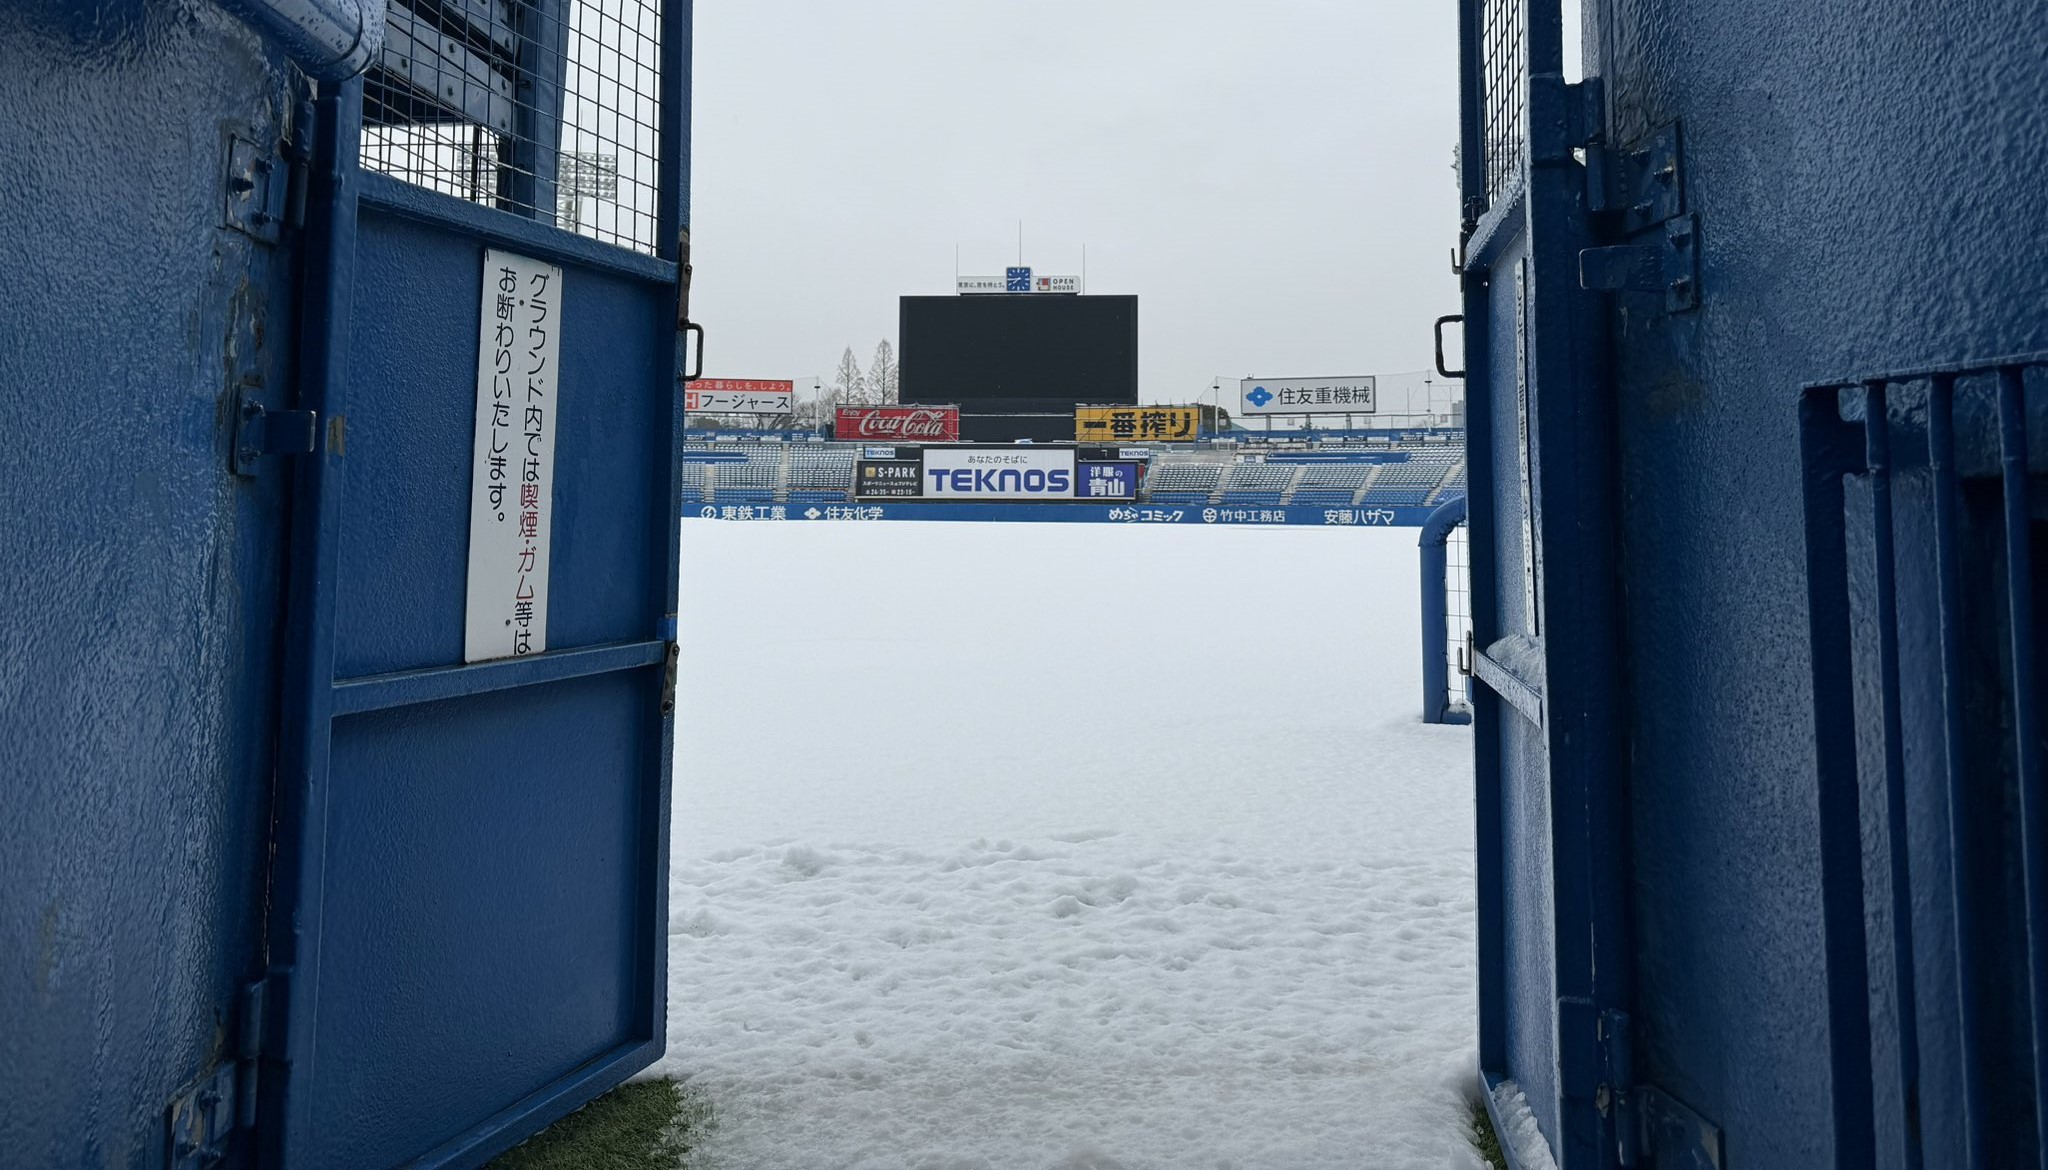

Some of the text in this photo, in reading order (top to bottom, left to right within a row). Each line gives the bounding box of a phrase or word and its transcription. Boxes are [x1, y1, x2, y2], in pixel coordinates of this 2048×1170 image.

[488, 267, 517, 523] お断わりいたします。
[701, 394, 789, 410] フージャース
[1277, 386, 1371, 406] 住友重機械
[842, 408, 860, 416] Enjoy
[1083, 411, 1191, 438] 一番搾り
[512, 272, 550, 655] グラウンド内では喫煙・ガム等は
[968, 456, 1028, 464] あなたのそばに
[1090, 466, 1123, 478] 洋服の
[928, 469, 1069, 492] TEKNOS
[1088, 478, 1126, 496] 青山
[721, 506, 787, 520] 東鉄工業
[824, 506, 884, 521] 住友化学
[1109, 507, 1184, 522] めちゃコミック
[1220, 509, 1286, 522] 竹中工務店
[1324, 509, 1395, 525] 安藤ハザマ
